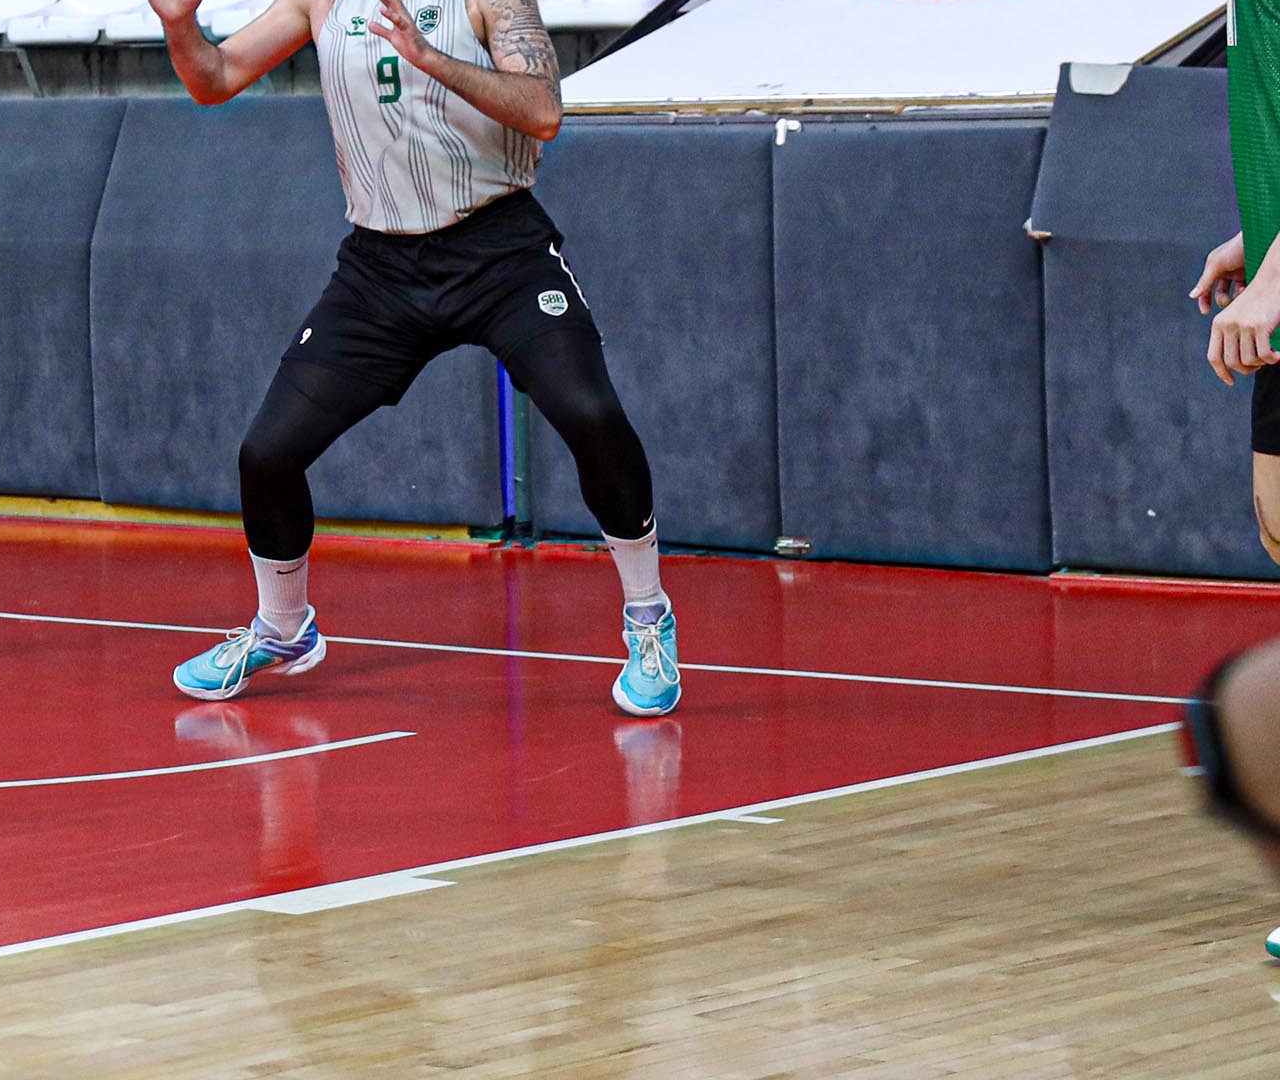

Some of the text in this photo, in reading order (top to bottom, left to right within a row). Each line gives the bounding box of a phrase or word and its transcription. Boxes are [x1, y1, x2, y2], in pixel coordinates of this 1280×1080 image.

[376, 56, 402, 104] 9
[541, 294, 565, 306] SBB
[299, 327, 313, 345] 9
